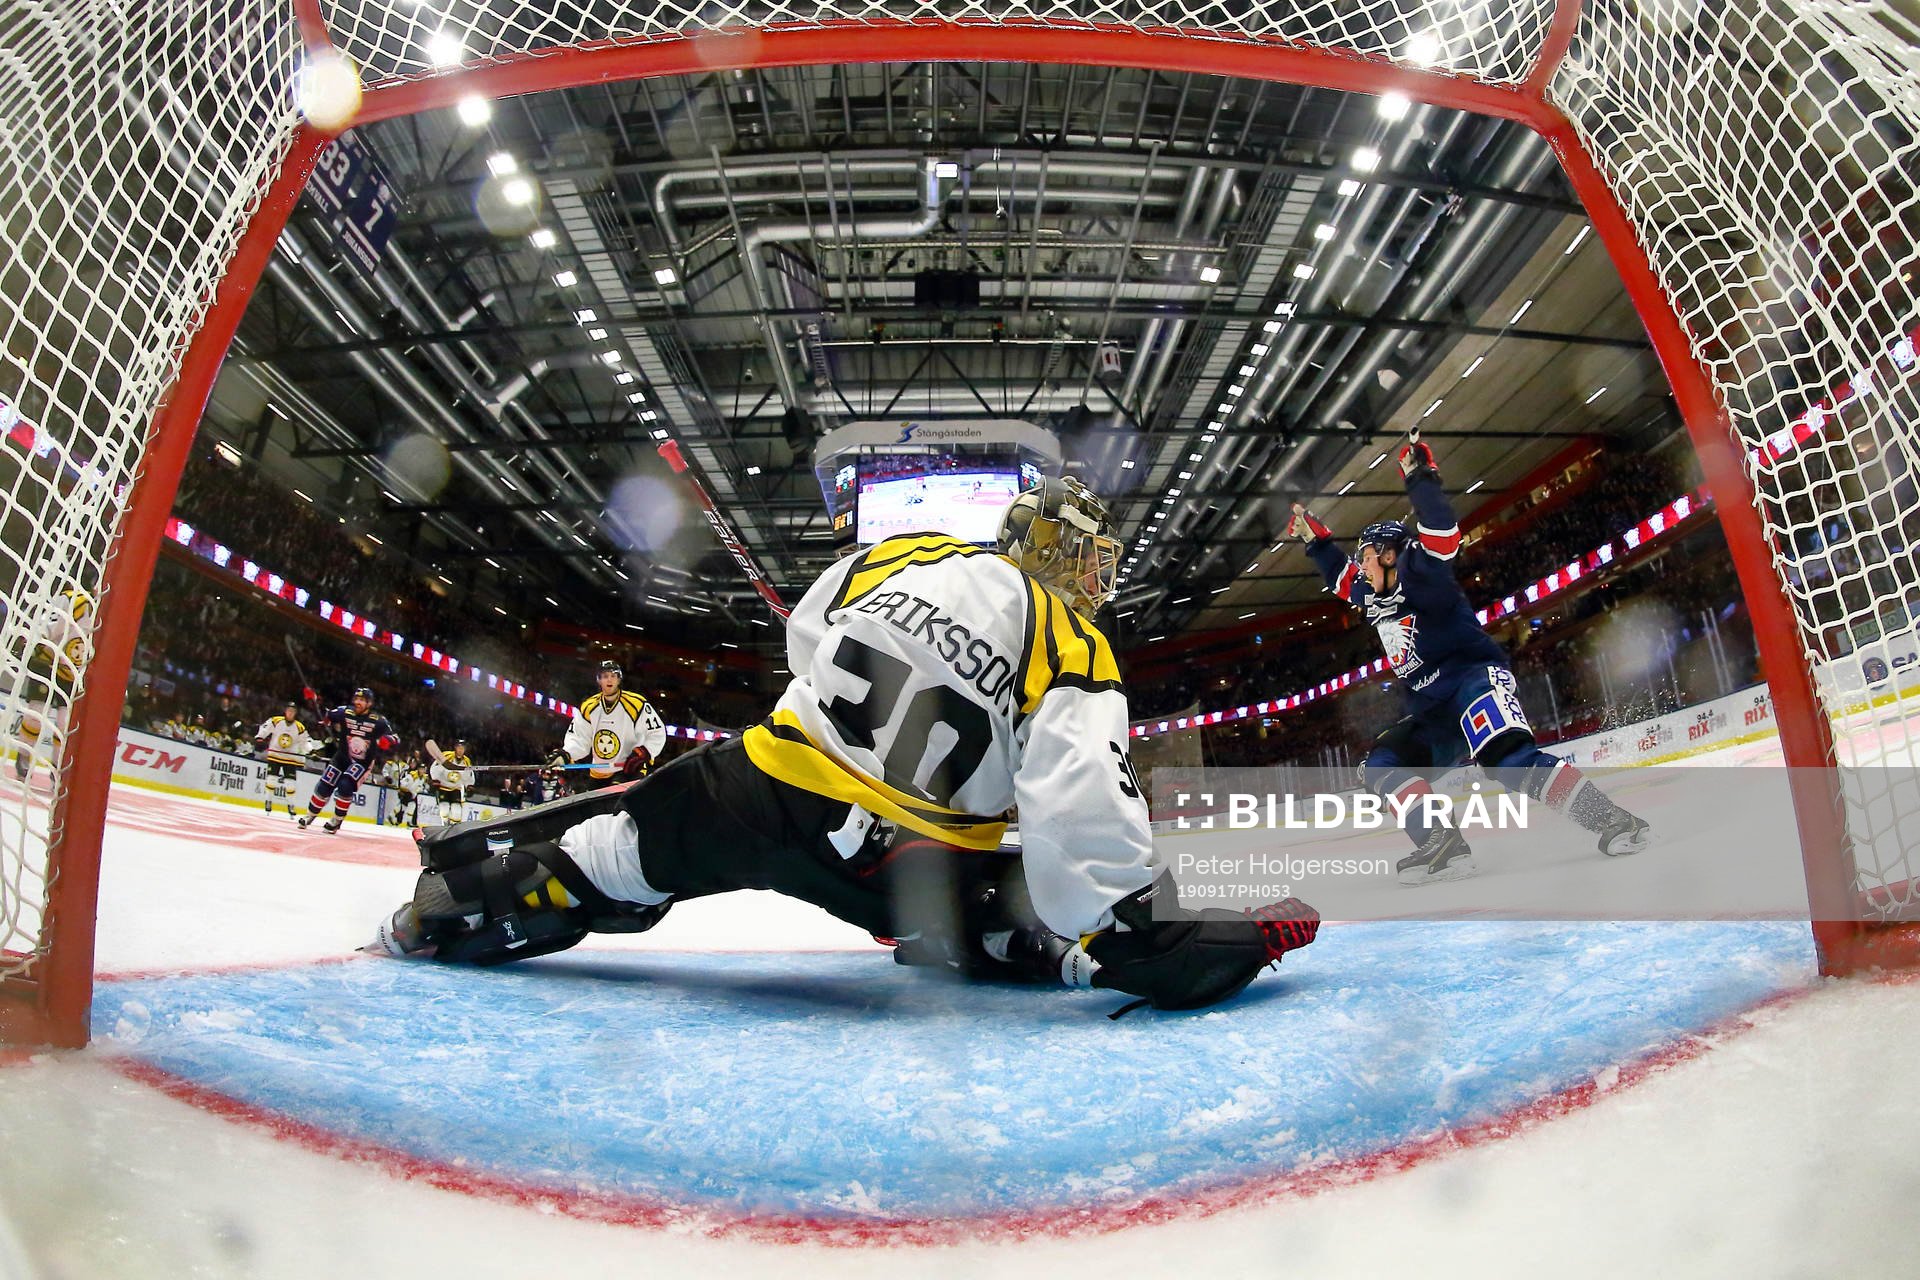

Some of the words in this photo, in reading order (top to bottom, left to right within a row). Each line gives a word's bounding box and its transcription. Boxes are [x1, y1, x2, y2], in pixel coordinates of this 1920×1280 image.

[365, 199, 384, 233] 7
[916, 427, 982, 441] Stångåstaden
[855, 591, 1016, 717] ERIKSSON
[645, 716, 662, 731] 11
[117, 741, 187, 773] CM
[210, 756, 248, 777] Linkan
